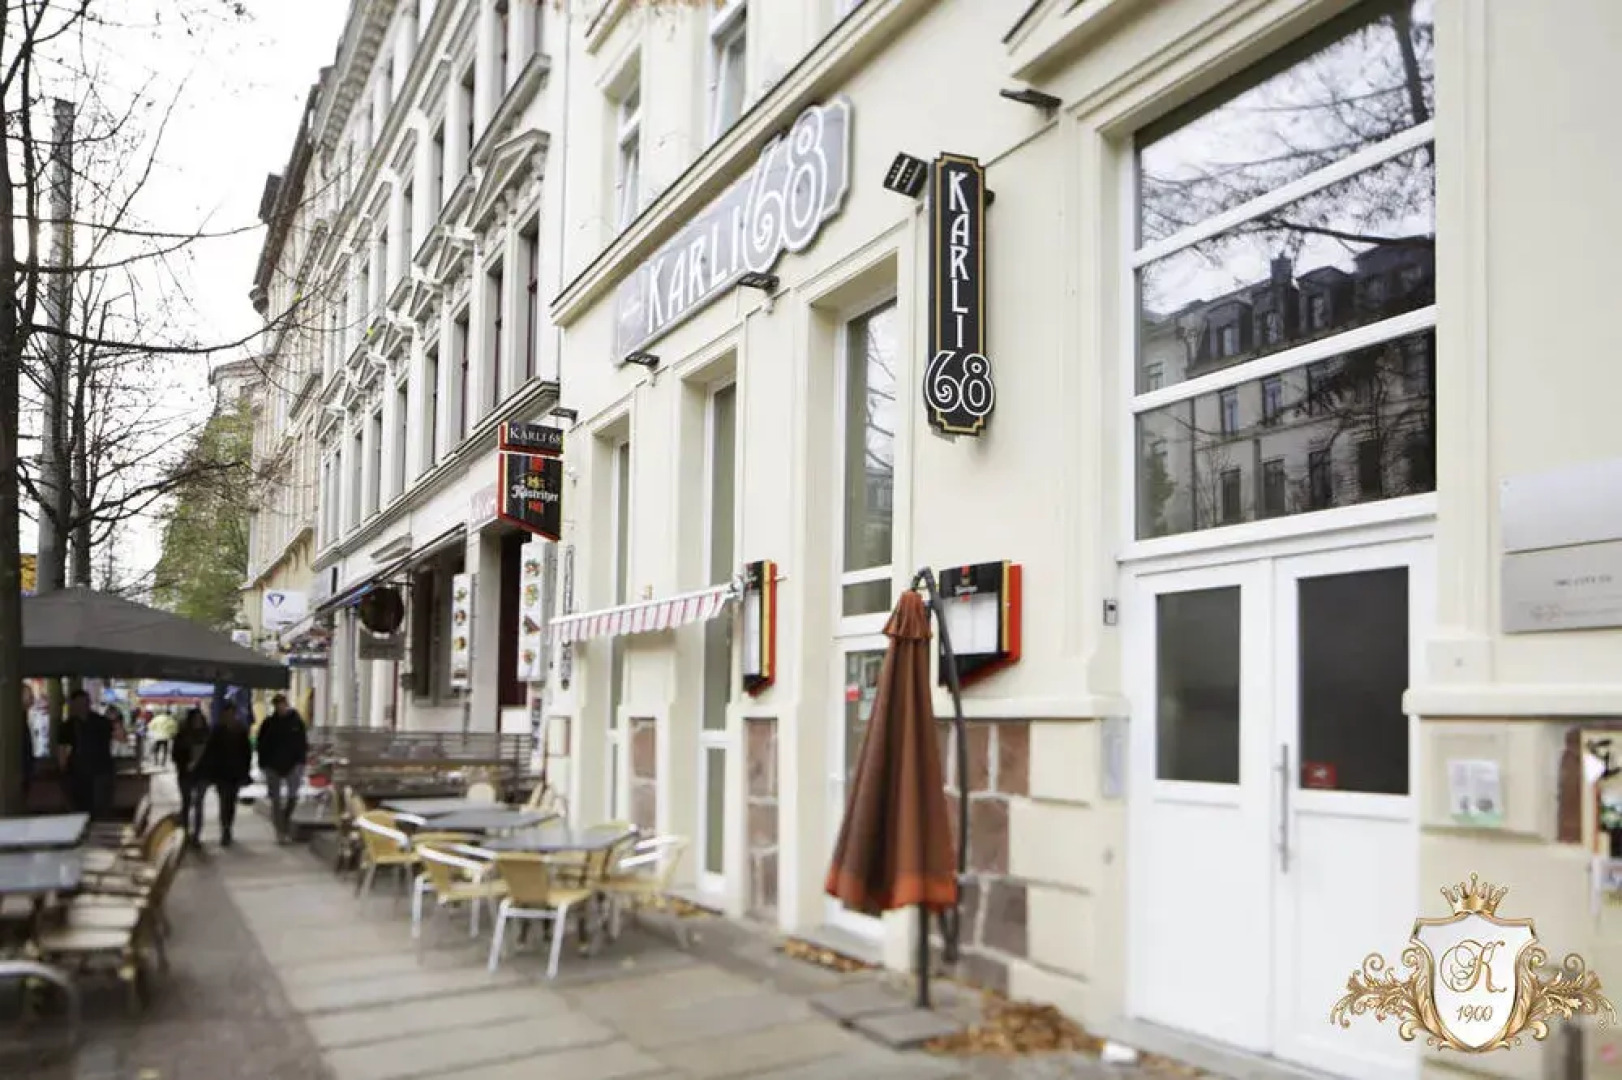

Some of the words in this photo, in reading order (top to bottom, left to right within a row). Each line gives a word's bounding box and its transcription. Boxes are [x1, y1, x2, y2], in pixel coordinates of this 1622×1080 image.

[645, 205, 740, 334] KARLI
[743, 108, 828, 272] 68
[948, 170, 971, 349] KARLI
[924, 350, 995, 417] 68
